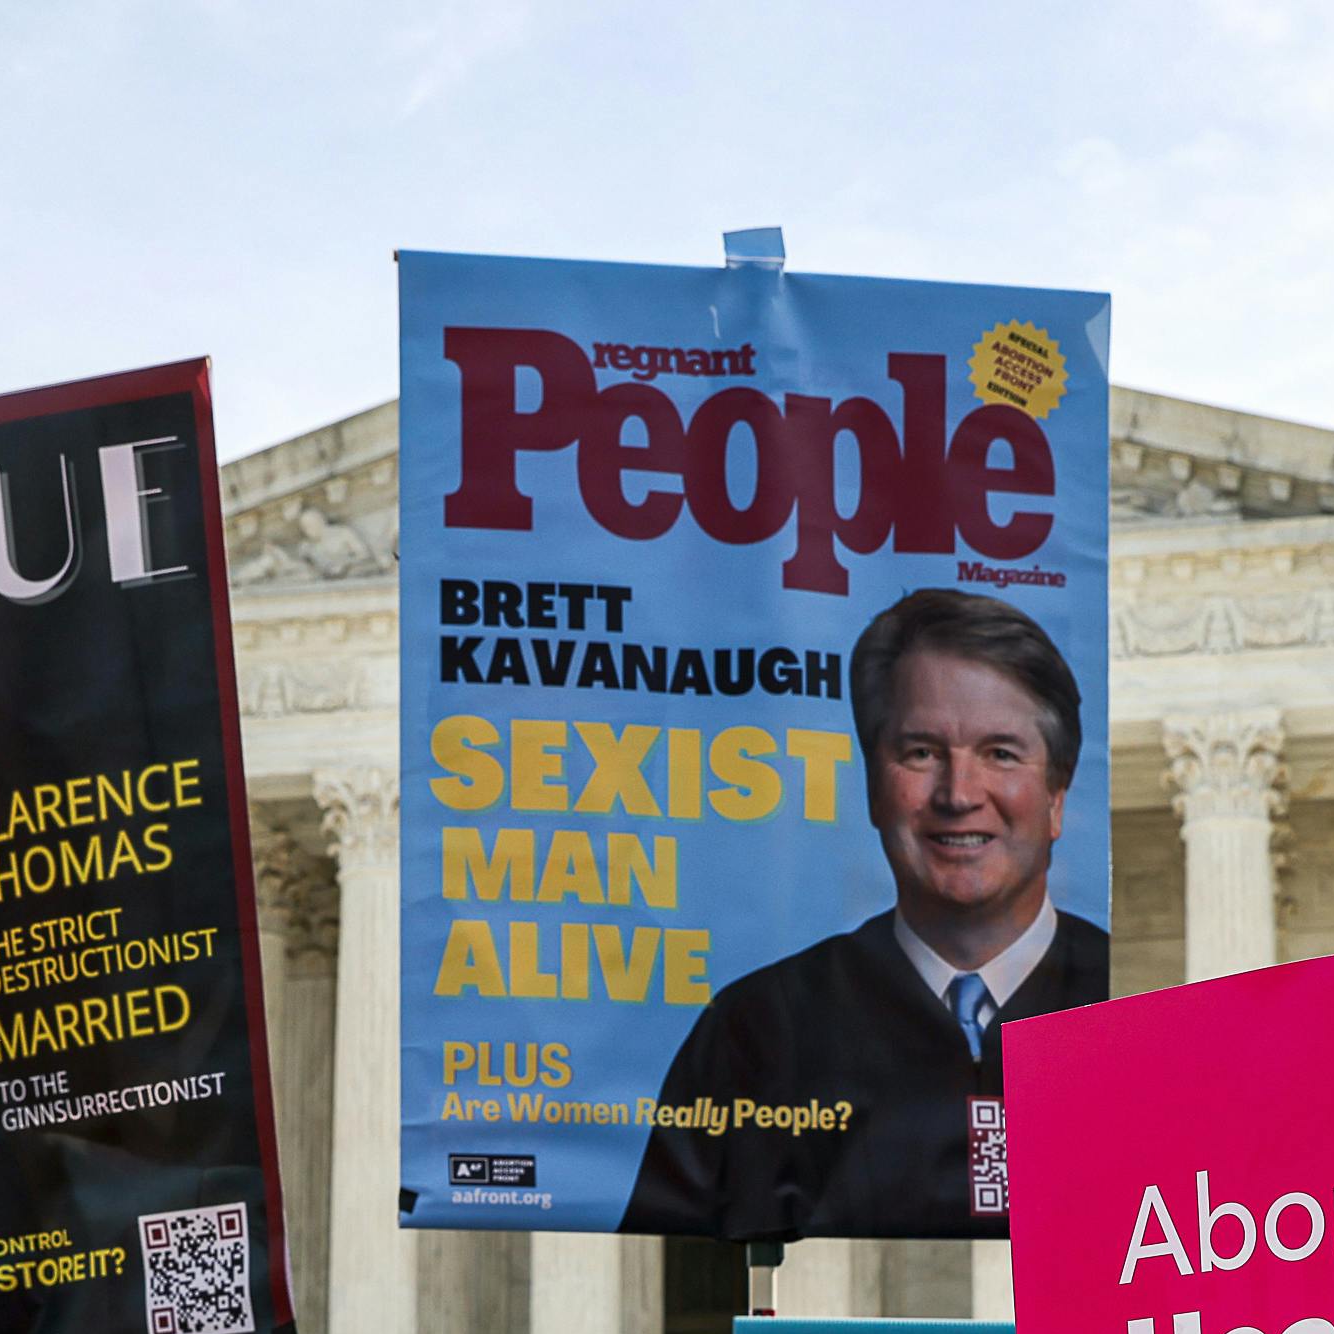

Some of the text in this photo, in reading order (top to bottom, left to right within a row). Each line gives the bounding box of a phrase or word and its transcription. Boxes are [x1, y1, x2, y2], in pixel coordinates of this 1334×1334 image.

[592, 340, 756, 382] regnant
[992, 342, 1054, 377] ABORTION
[994, 356, 1042, 384] ACCESS
[994, 367, 1034, 393] FRONT
[443, 325, 1056, 597] People
[956, 561, 1065, 589] Magazine
[440, 578, 632, 632] BRETT
[440, 636, 841, 700] KAVANAUGH
[429, 714, 852, 822] SEXIST
[441, 827, 677, 909] MAN
[30, 908, 122, 952] STRICT
[433, 920, 711, 1005] ALIVE
[29, 1070, 69, 1096] THE
[442, 1041, 572, 1088] PLUS
[1, 1072, 226, 1131] GINNSURRECTIONIST
[440, 1092, 852, 1136] Are Women Really People?
[452, 1187, 552, 1210] aafront.org
[88, 1247, 126, 1279] IT?
